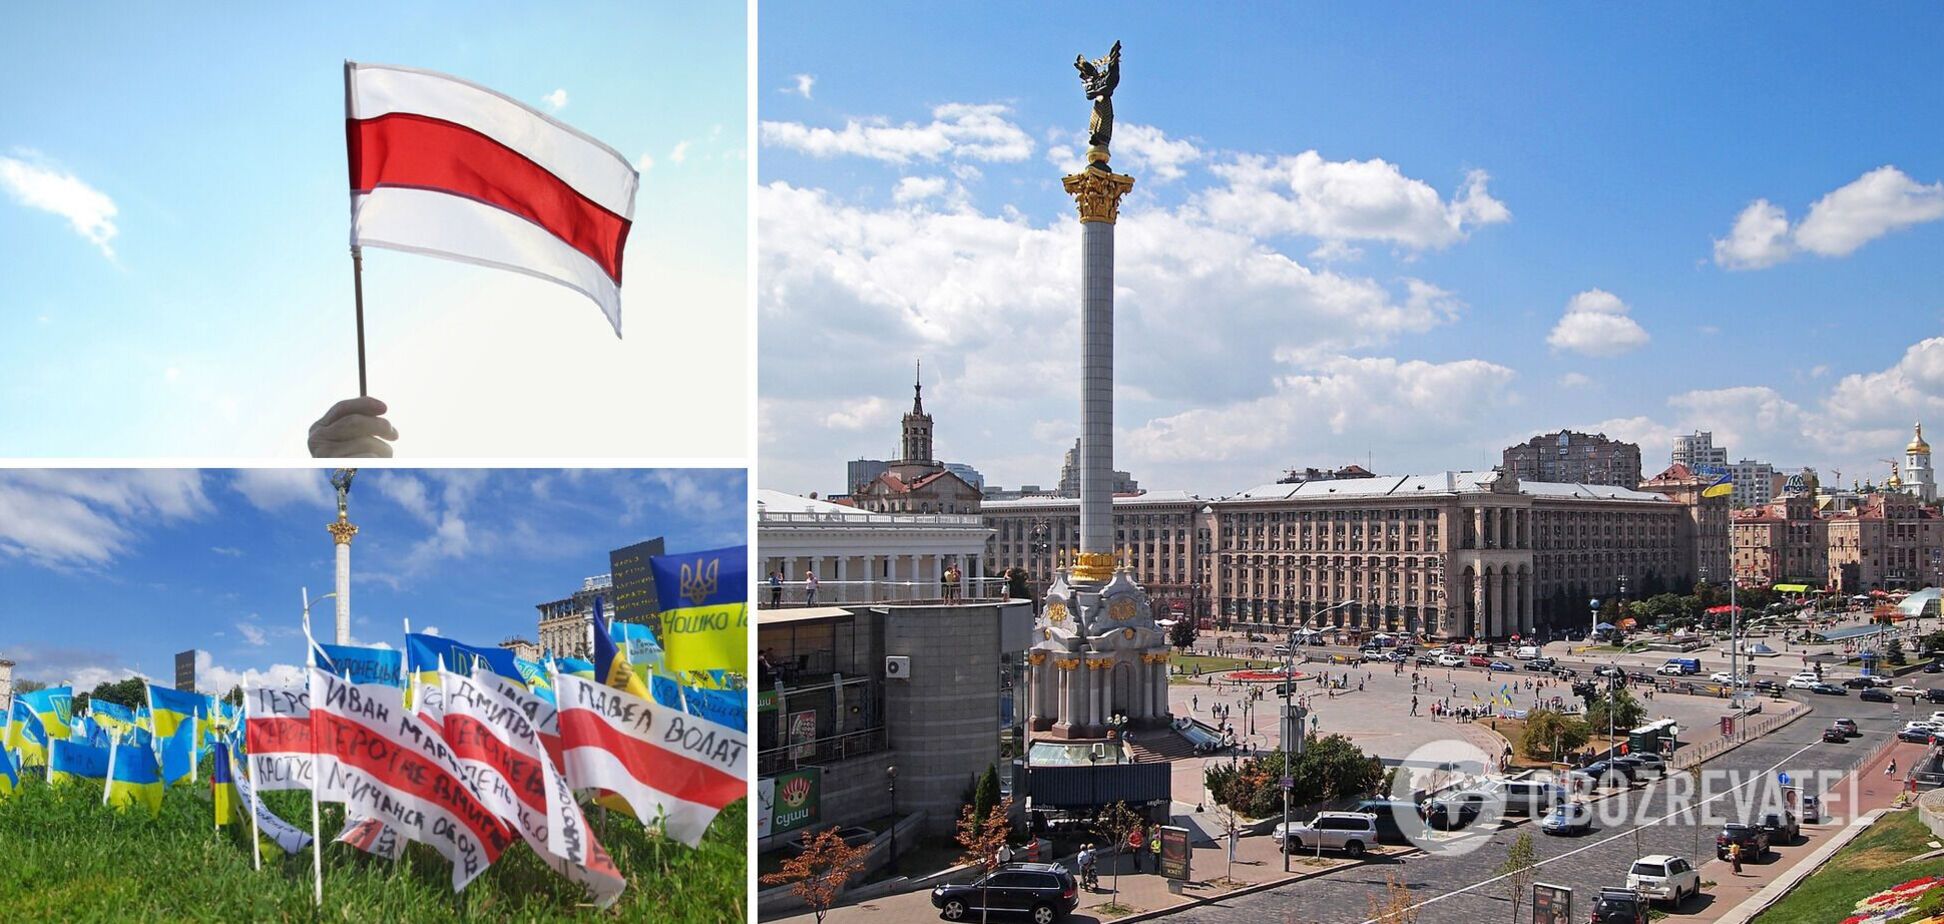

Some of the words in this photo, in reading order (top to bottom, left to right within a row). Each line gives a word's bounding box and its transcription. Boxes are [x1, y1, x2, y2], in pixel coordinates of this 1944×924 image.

[326, 676, 389, 722] ИВАН
[451, 680, 536, 746] ДМИТРИ
[578, 680, 653, 733] ПАВЕЛ
[664, 716, 748, 768] ВОЛАТ
